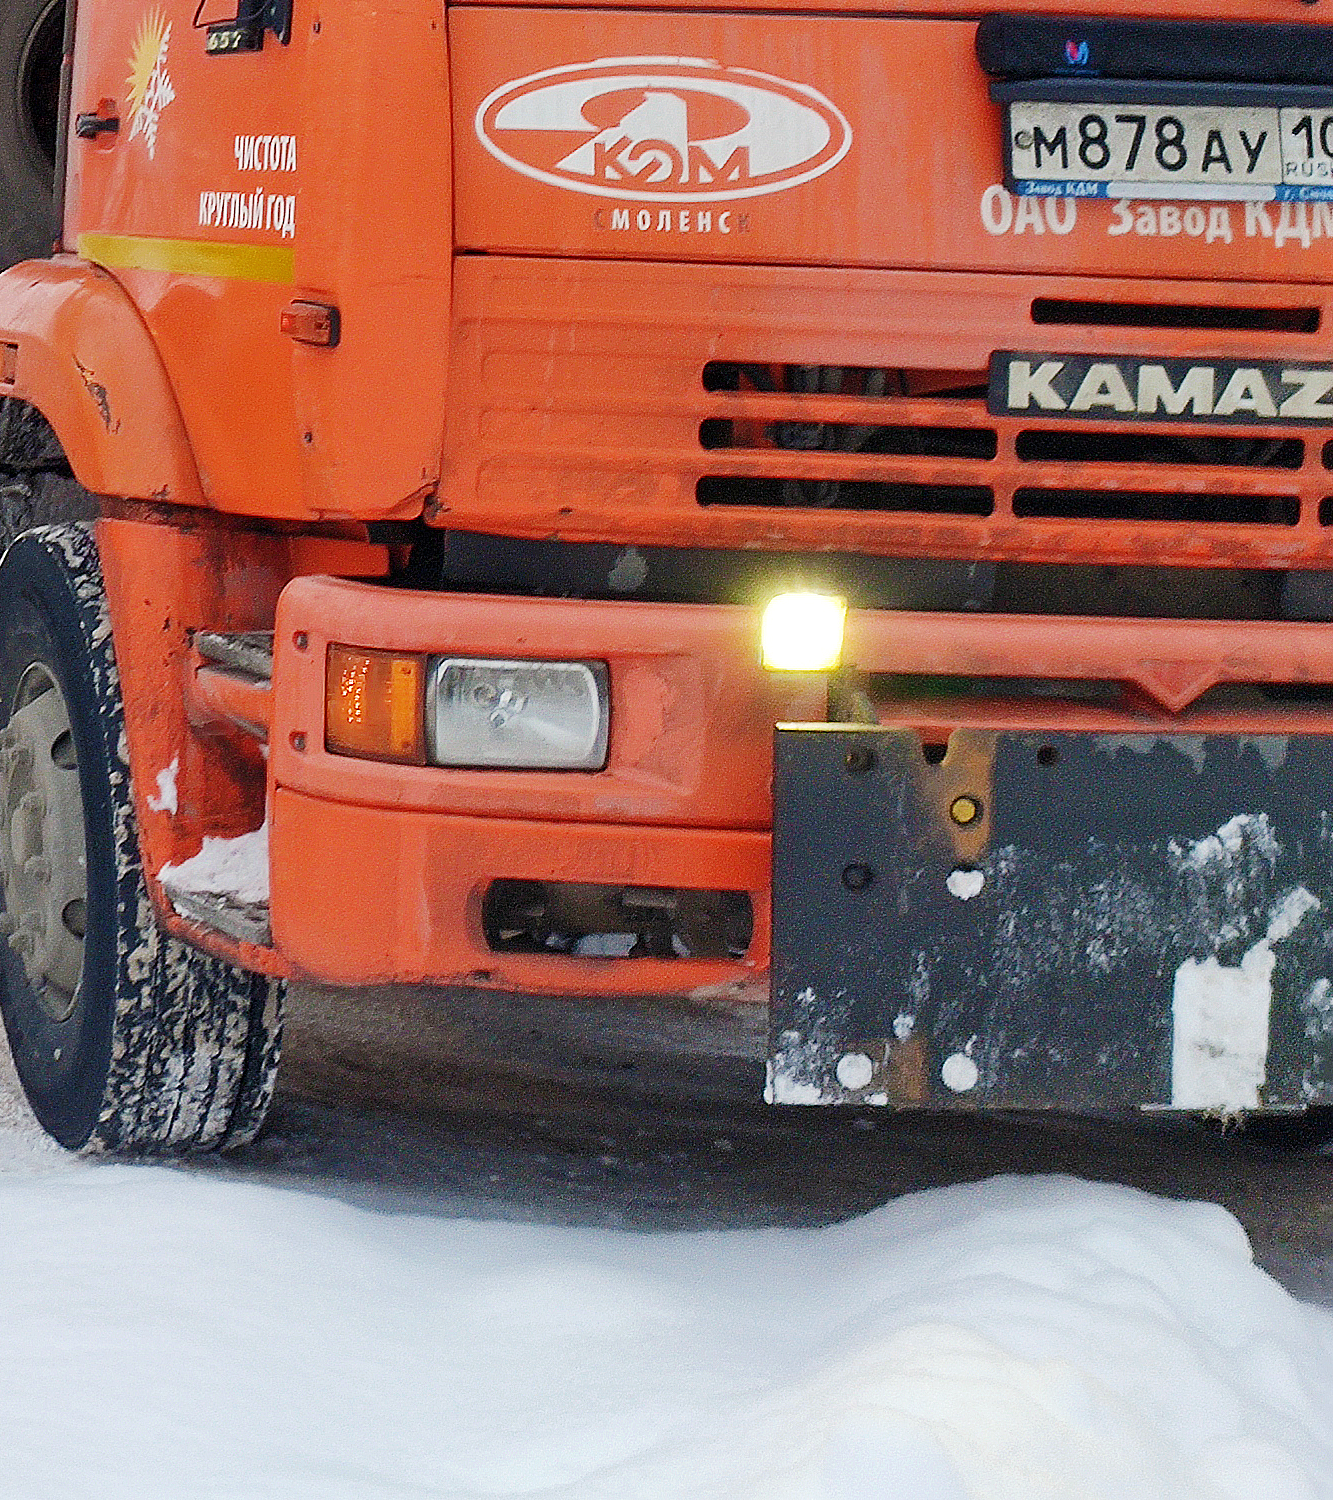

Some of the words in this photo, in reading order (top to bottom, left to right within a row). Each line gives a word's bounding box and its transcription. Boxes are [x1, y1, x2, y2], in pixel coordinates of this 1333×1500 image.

[234, 135, 297, 172] ЧИСТОТА
[199, 186, 264, 231] КРУГЛЫЙ
[265, 194, 296, 239] ГОД
[980, 183, 1079, 236] ОАО
[1107, 200, 1233, 244] Завод
[1007, 360, 1333, 419] KAMAZ
